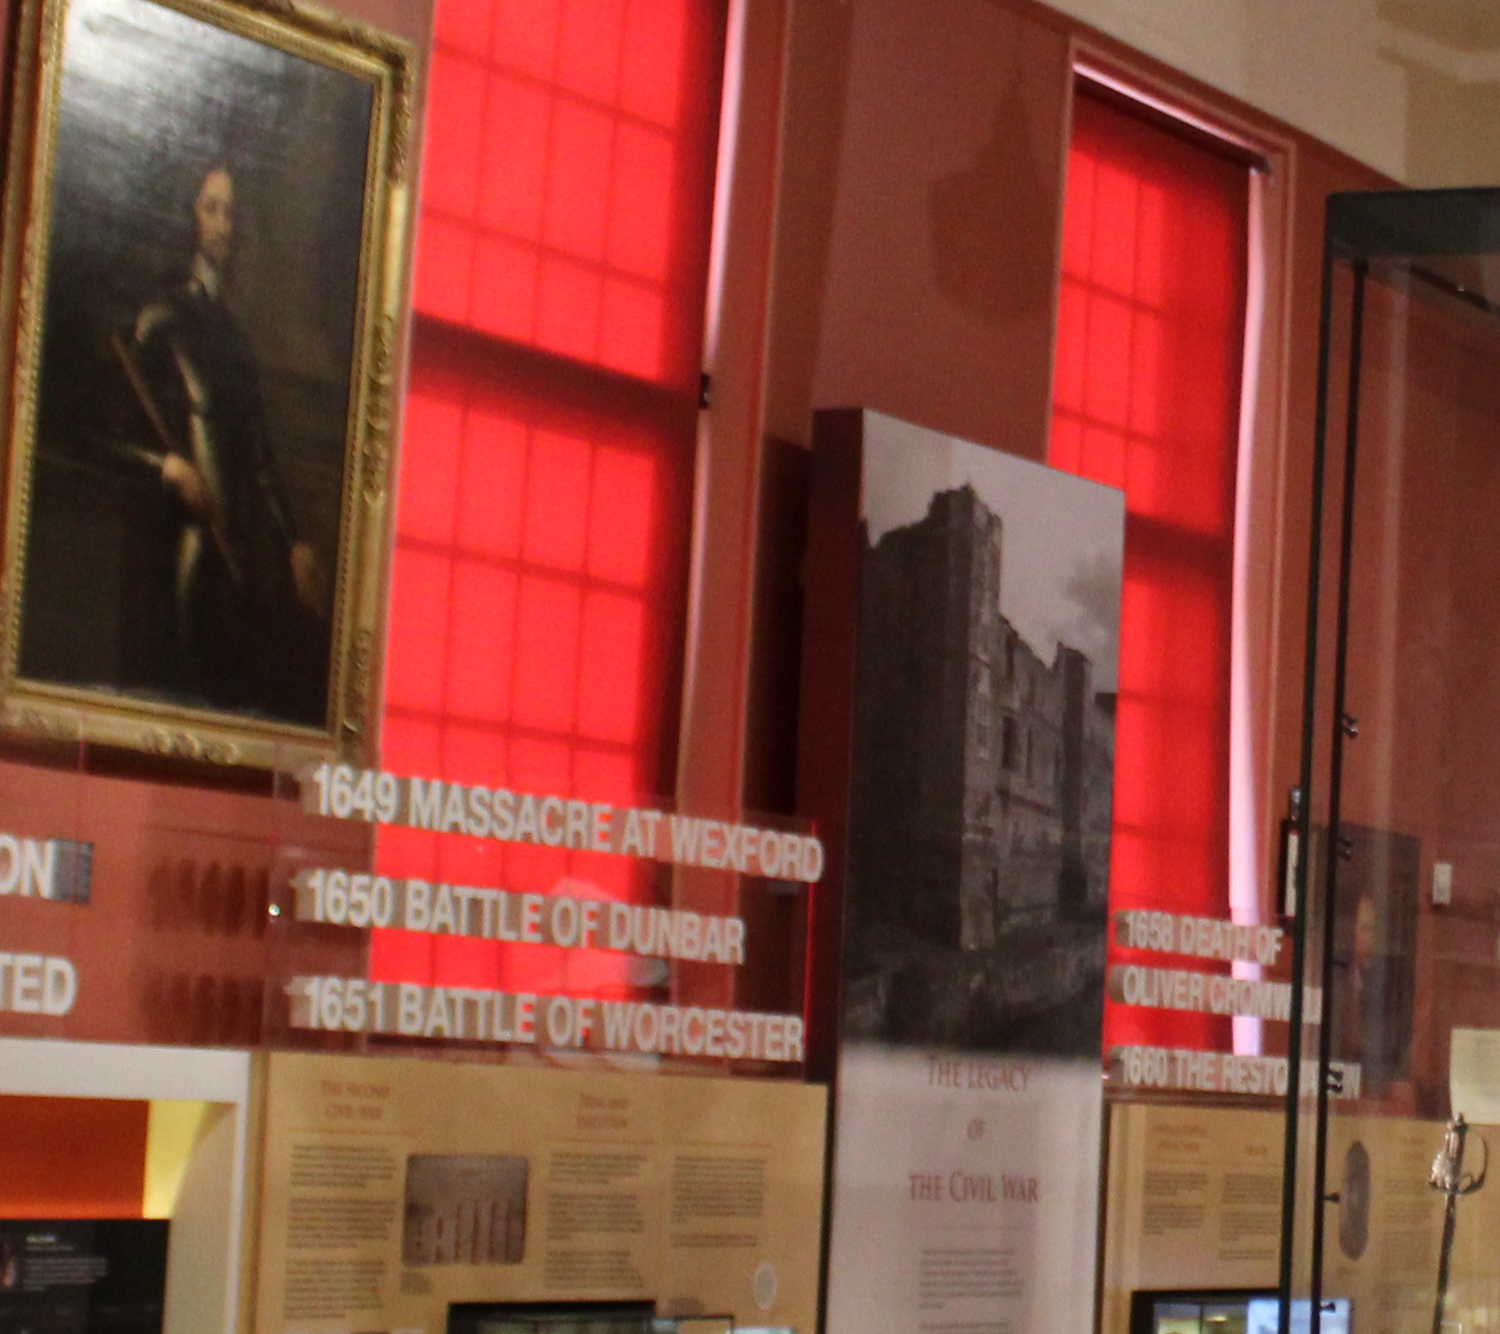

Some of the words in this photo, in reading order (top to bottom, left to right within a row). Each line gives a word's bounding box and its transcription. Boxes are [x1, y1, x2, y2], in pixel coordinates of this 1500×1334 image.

[314, 765, 398, 823] 1649
[409, 776, 613, 853] MASSACRE
[620, 809, 660, 858] AT
[670, 814, 825, 883] WEXFORD
[307, 871, 393, 928] 1650
[404, 881, 542, 943] BATTLE
[551, 898, 599, 948] OF
[609, 903, 745, 965] DUNBAR
[1180, 917, 1251, 960] DEATH
[1256, 926, 1283, 965] OF
[1123, 965, 1205, 1013] OLIVER
[303, 977, 388, 1033] 1651
[401, 986, 534, 1042] BATTLE
[548, 1002, 594, 1047] OF
[603, 1004, 805, 1062] WORCESTER
[926, 1053, 962, 1088] THE
[968, 1060, 1030, 1092] LEGACY
[1121, 1046, 1168, 1085] 1660
[1174, 1050, 1218, 1090] THE
[909, 1171, 942, 1201] THE
[950, 1170, 996, 1203] CIVIL
[1002, 1173, 1039, 1203] WAR
